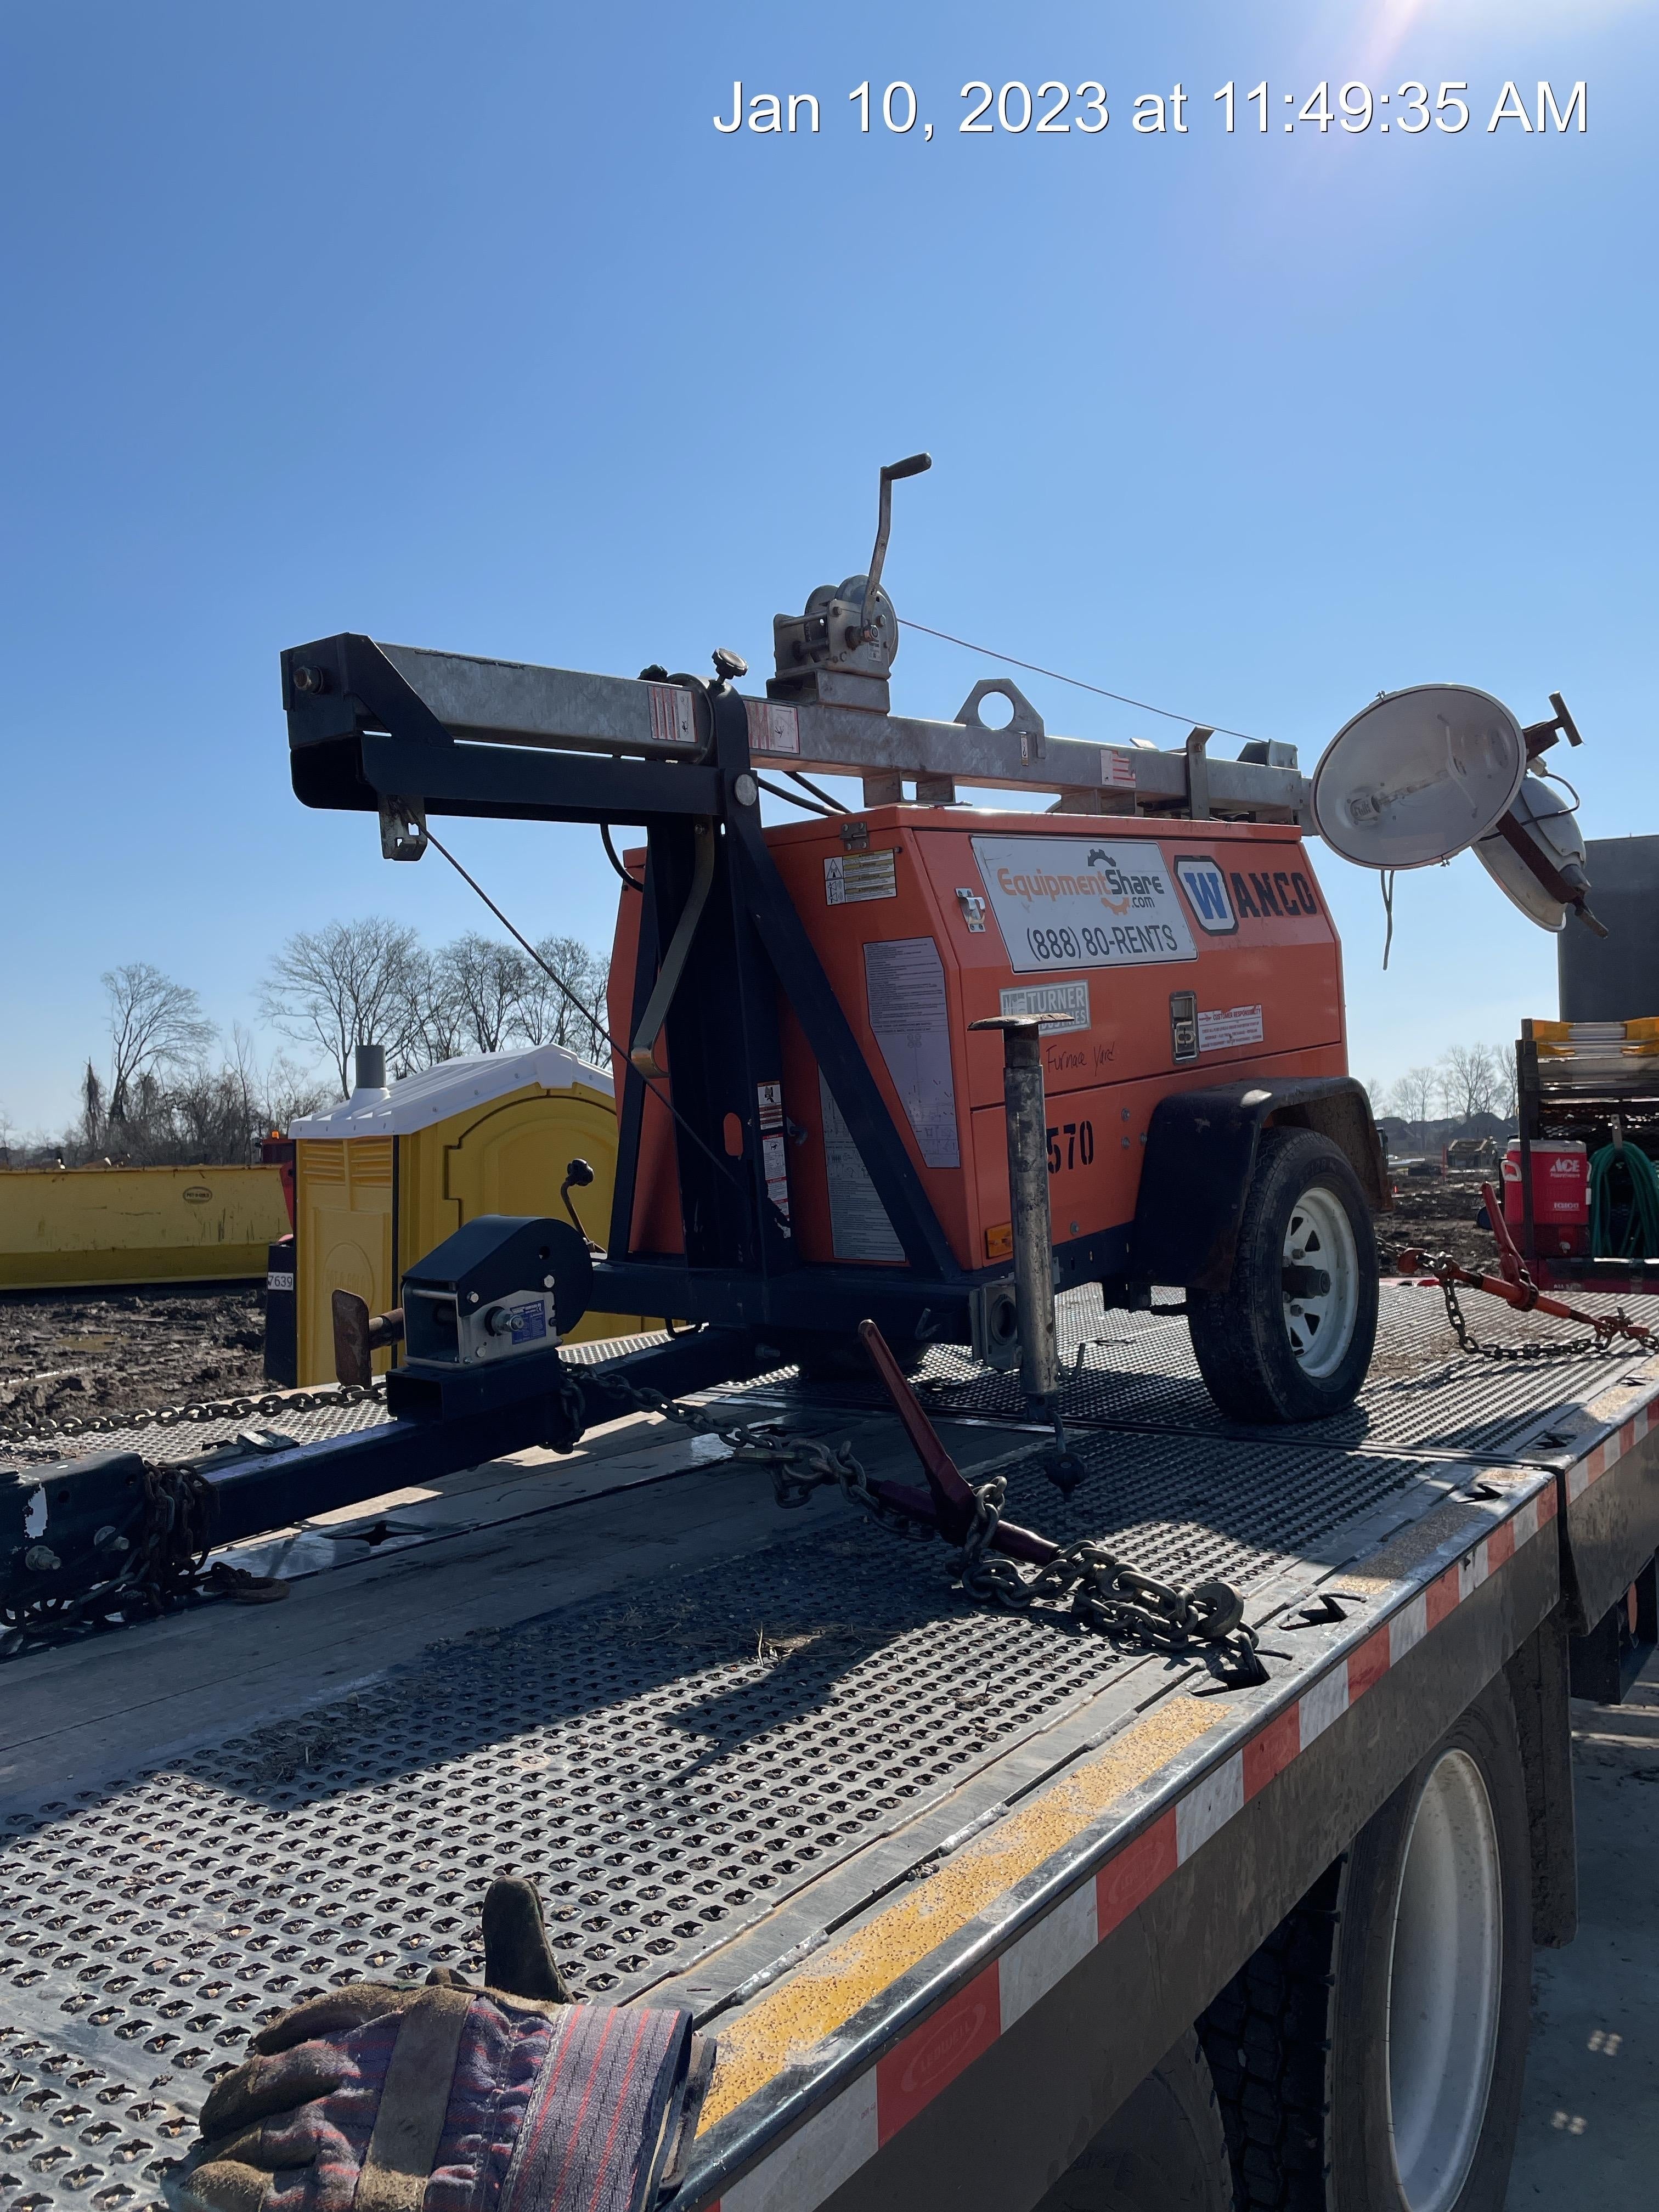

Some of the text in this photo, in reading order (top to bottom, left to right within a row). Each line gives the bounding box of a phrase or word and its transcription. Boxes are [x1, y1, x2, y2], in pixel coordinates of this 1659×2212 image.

[997, 868, 1164, 901] EquipmentShare
[1183, 872, 1317, 919] WANCO
[1131, 896, 1155, 909] .com
[1026, 924, 1178, 962] (888) 80-RENTS
[1028, 988, 1085, 1014] TURNER
[1212, 1012, 1233, 1021] CUSTOMER
[1046, 1041, 1115, 1076] Furnace Yard
[1046, 1120, 1094, 1174] 570
[1550, 1157, 1580, 1172] ACE
[268, 1276, 292, 1288] 7639
